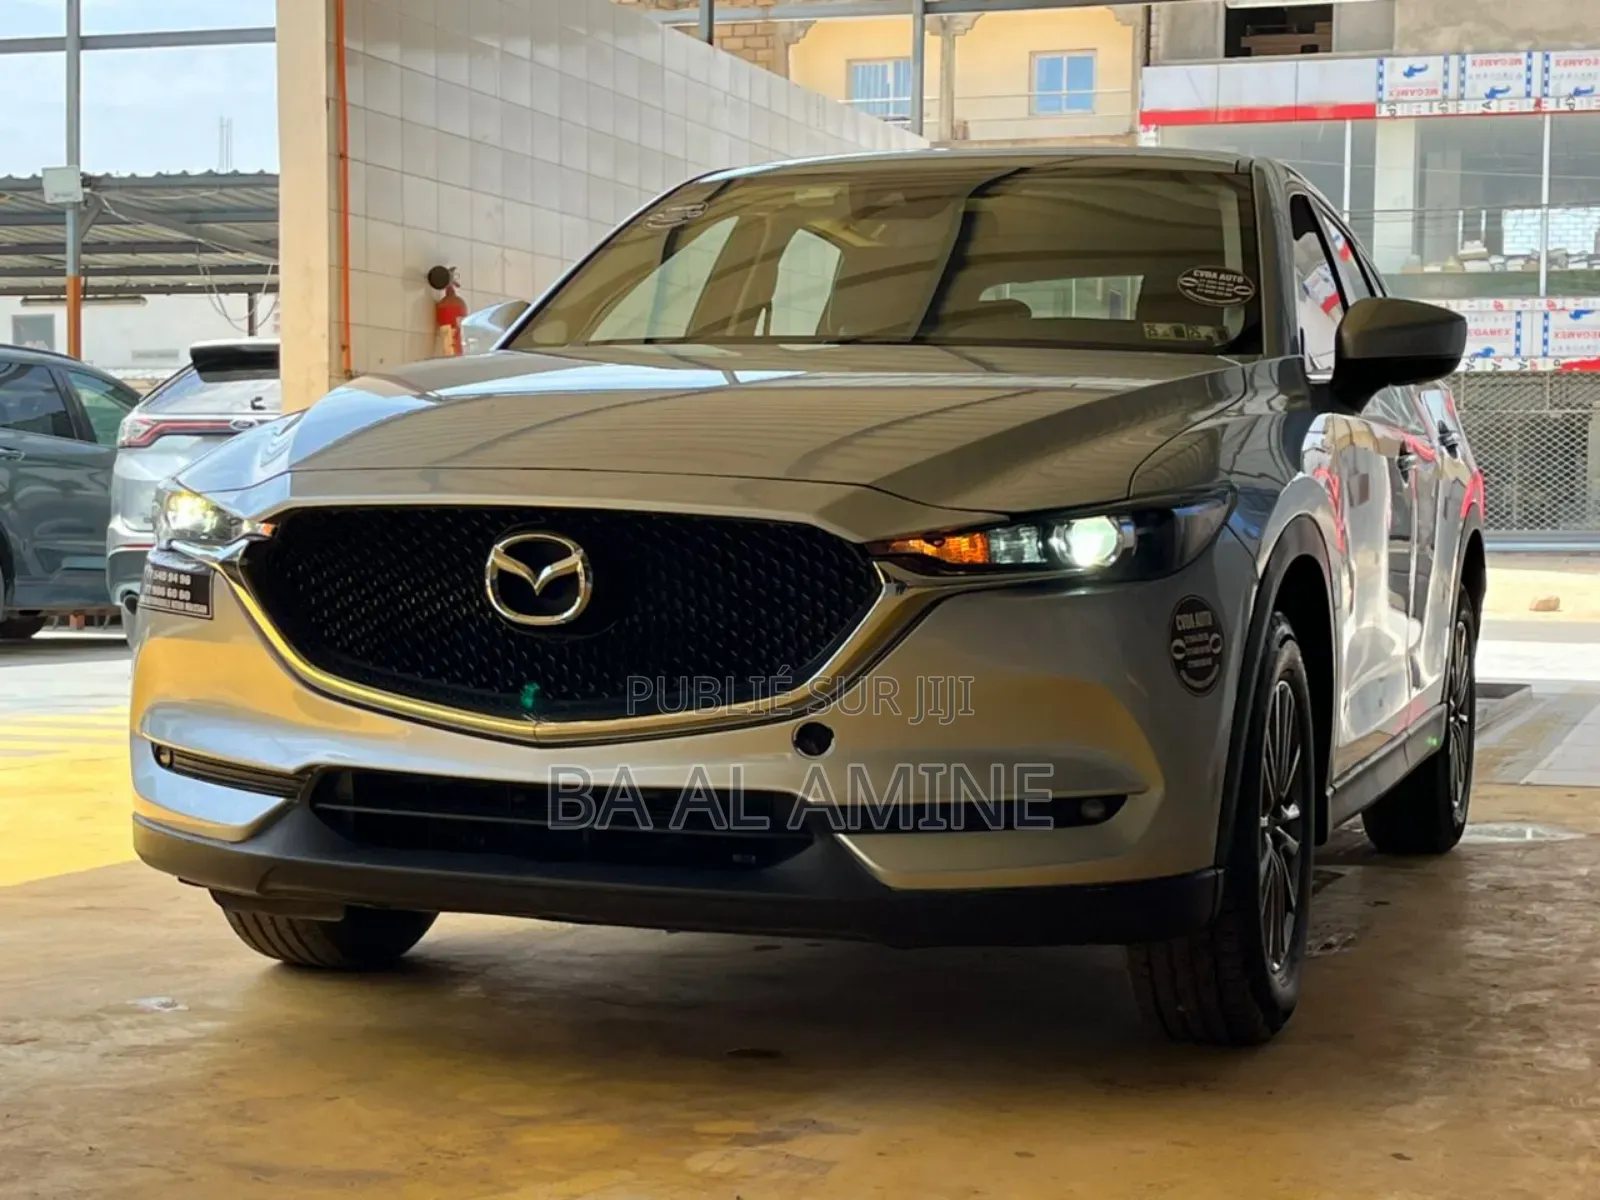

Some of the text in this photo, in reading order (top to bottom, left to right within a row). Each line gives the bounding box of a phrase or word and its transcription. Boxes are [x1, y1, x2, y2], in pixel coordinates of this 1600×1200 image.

[1555, 58, 1600, 67] EGAMEX
[1219, 273, 1244, 283] AUTO
[1468, 327, 1512, 336] EGAMEX
